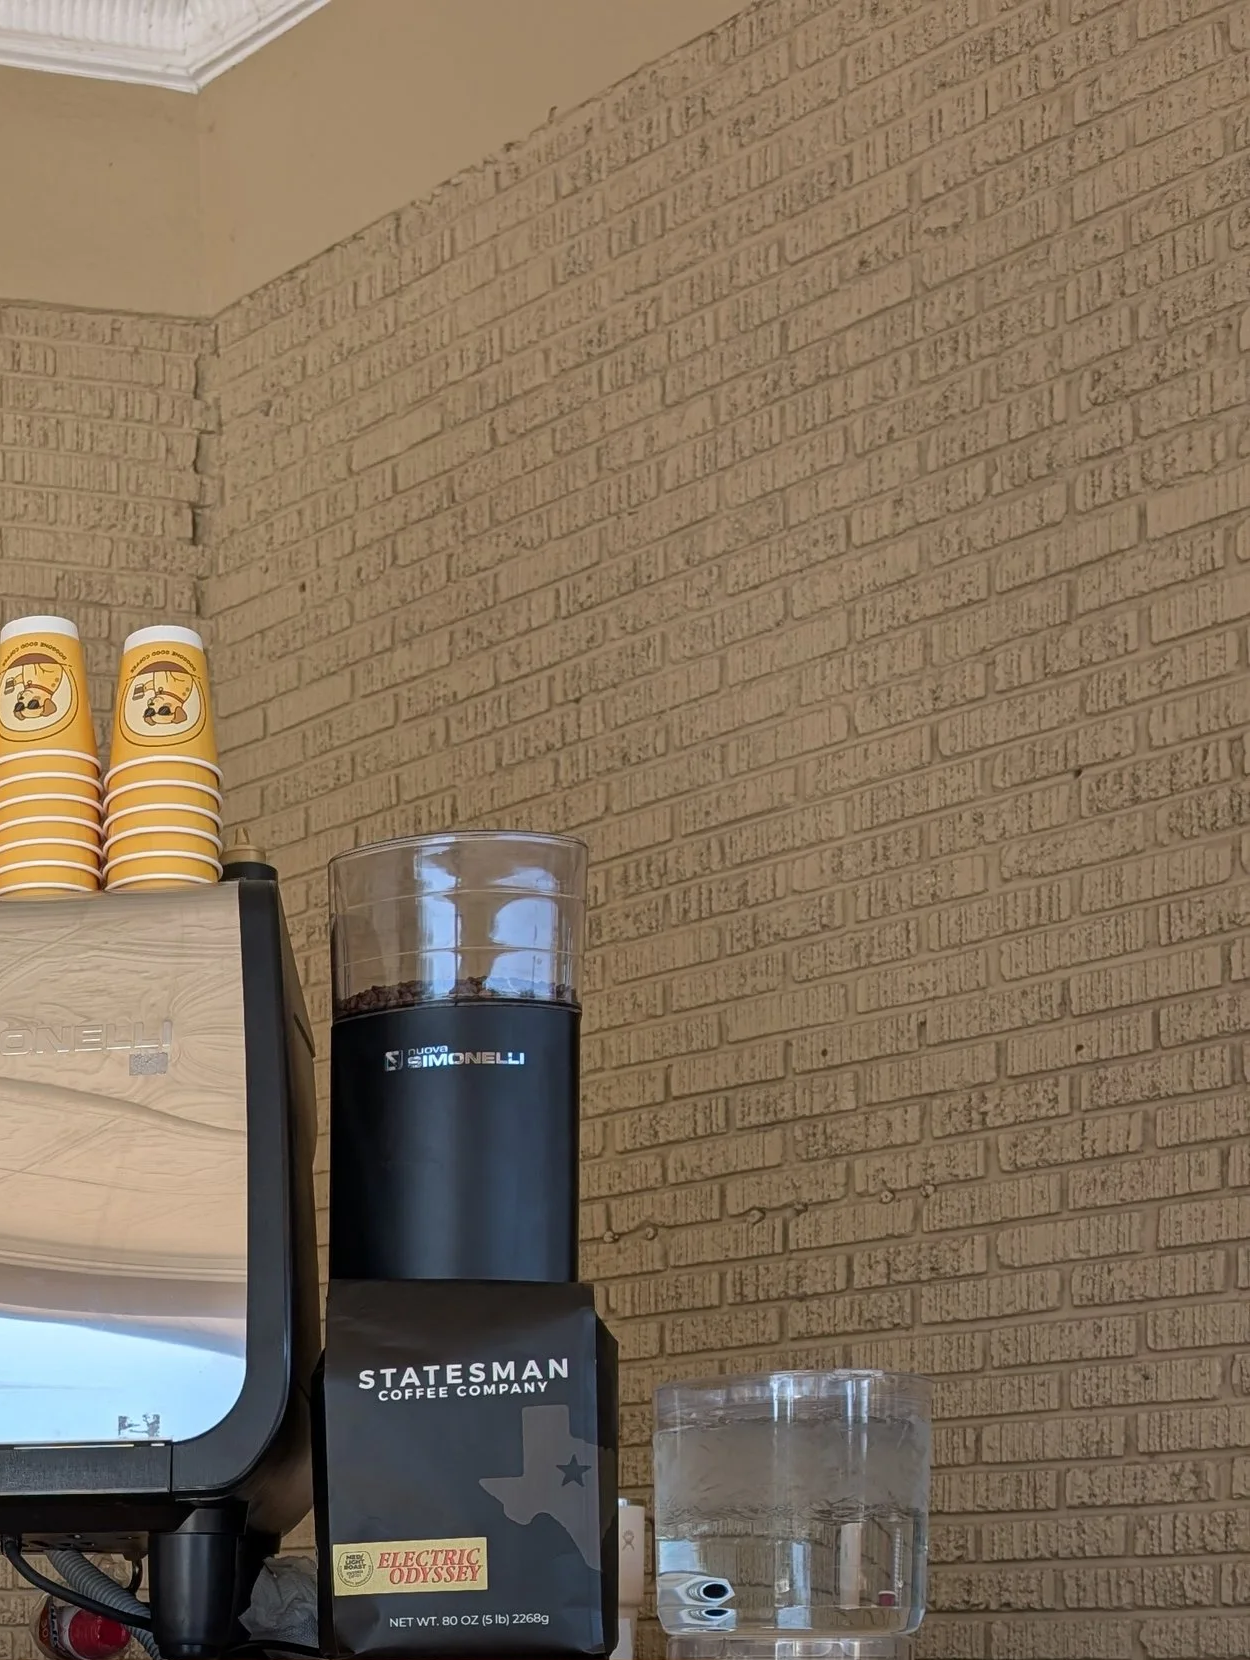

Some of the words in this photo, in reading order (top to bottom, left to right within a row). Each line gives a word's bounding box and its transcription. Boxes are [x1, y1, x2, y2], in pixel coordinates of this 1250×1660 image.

[407, 1044, 448, 1056] nuova
[407, 1051, 525, 1069] SIMONELLI
[358, 1357, 569, 1390] STATESMAN
[378, 1386, 449, 1402] COFFEE
[456, 1381, 548, 1397] COMPANY
[376, 1547, 481, 1569] ELECTRIC
[389, 1565, 482, 1585] ODYSSEY
[389, 1617, 414, 1628] NET
[416, 1616, 439, 1627] WT.
[441, 1615, 458, 1626] 80
[460, 1615, 479, 1626] OZ
[481, 1614, 493, 1627] (5
[494, 1614, 510, 1627] lb)
[512, 1613, 549, 1626] 2268g
